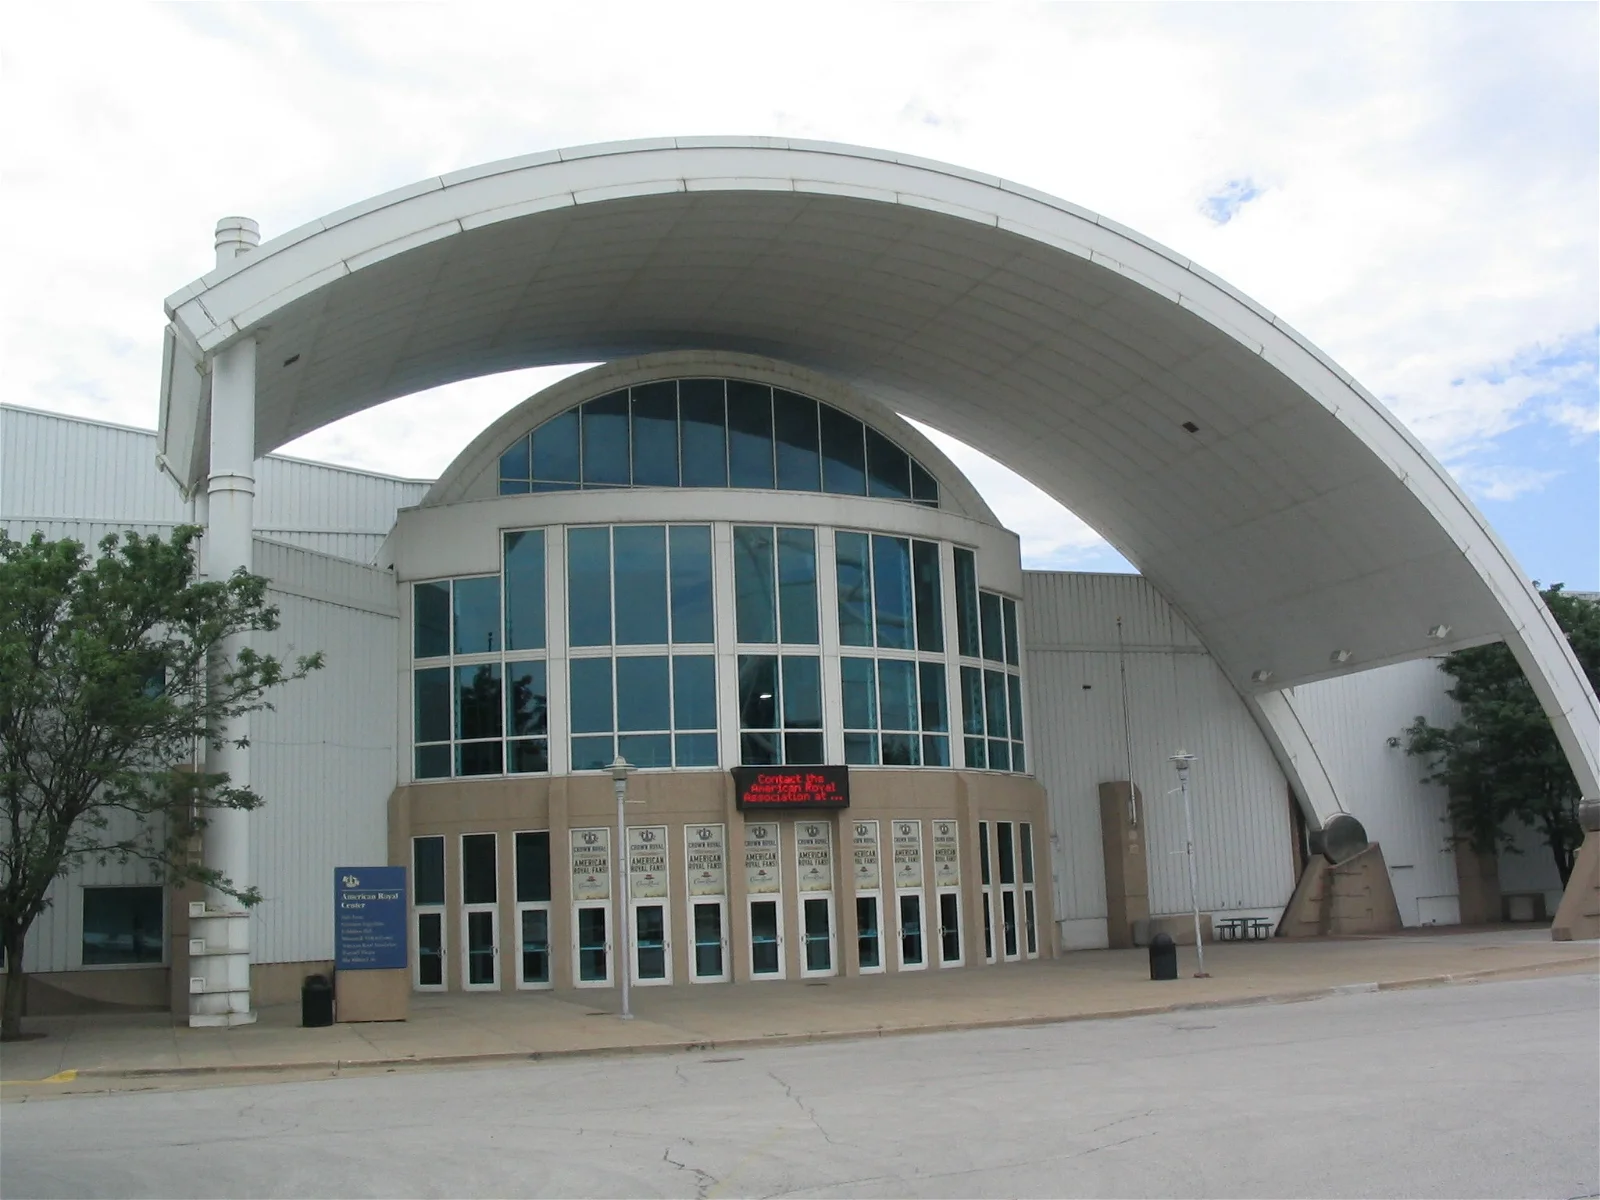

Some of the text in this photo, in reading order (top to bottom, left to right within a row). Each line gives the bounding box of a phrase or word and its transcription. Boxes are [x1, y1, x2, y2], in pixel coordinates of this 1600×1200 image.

[758, 774, 824, 783] Contact the
[751, 782, 836, 792] American Royal
[744, 793, 810, 802] Association
[815, 792, 826, 800] at
[377, 893, 398, 901] Royal
